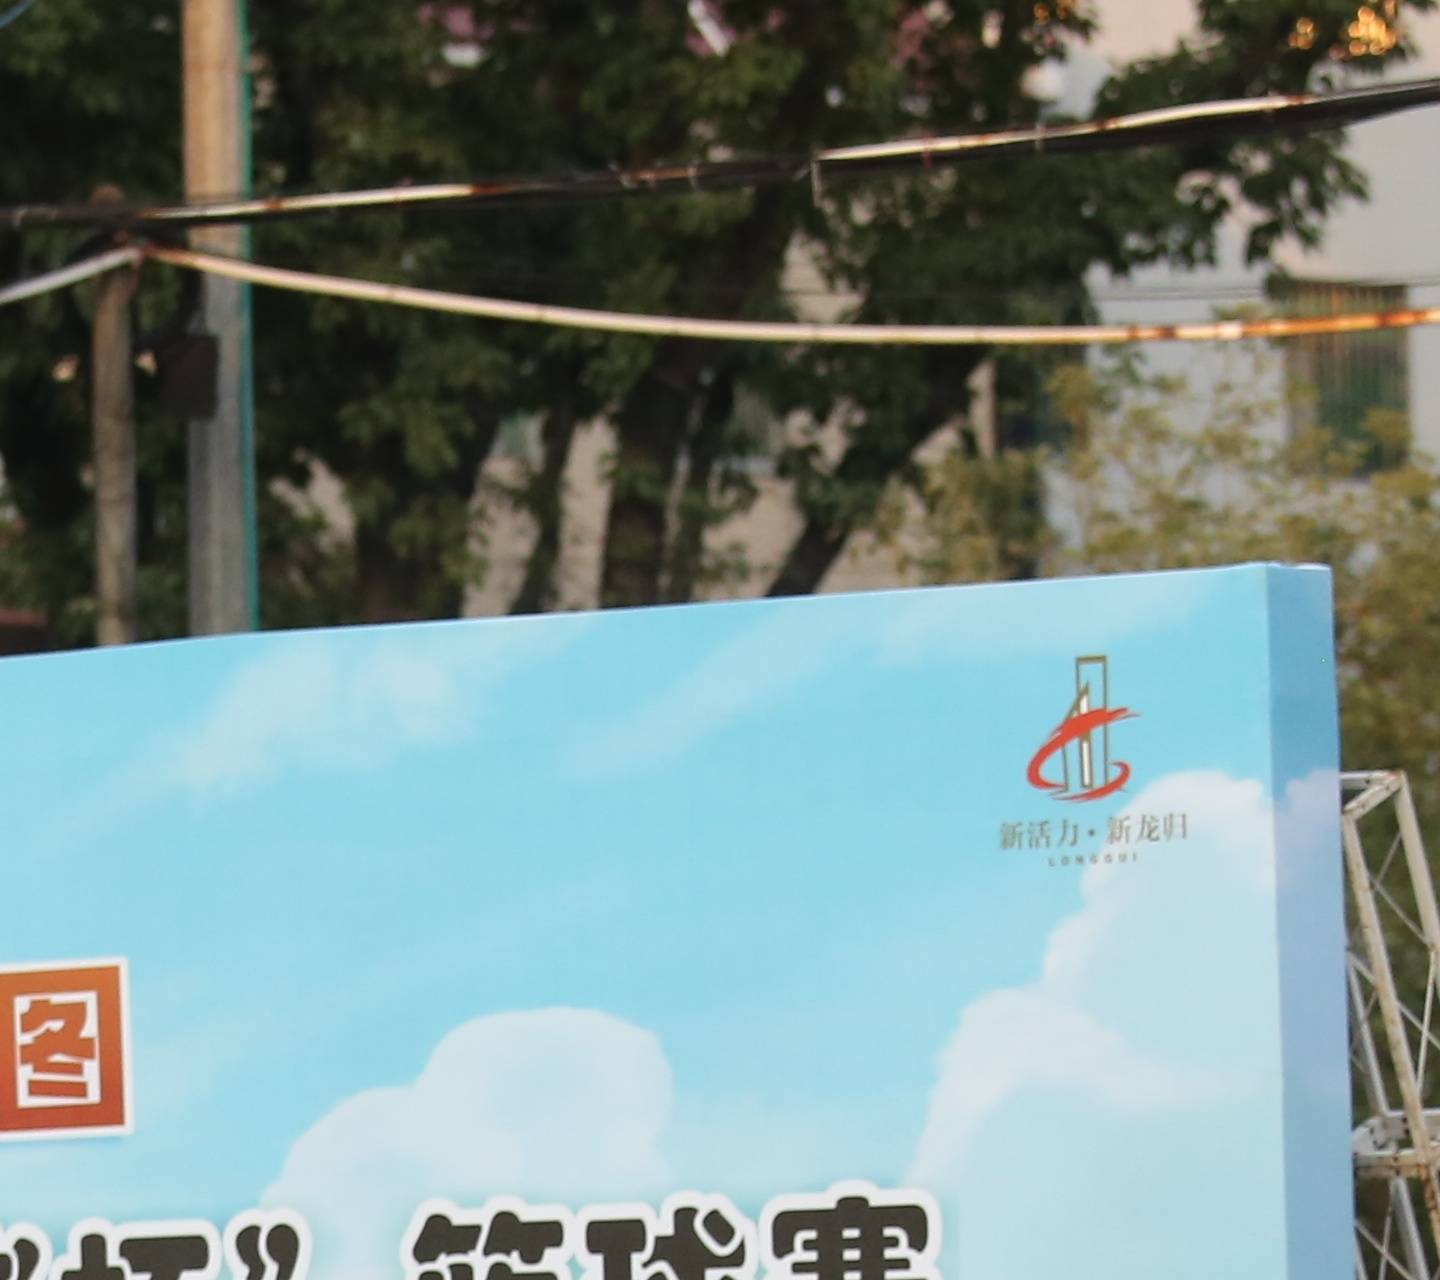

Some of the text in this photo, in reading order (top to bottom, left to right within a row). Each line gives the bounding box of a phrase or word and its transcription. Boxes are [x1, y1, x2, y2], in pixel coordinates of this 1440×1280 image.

[999, 812, 1189, 850] 新活力·新龙归
